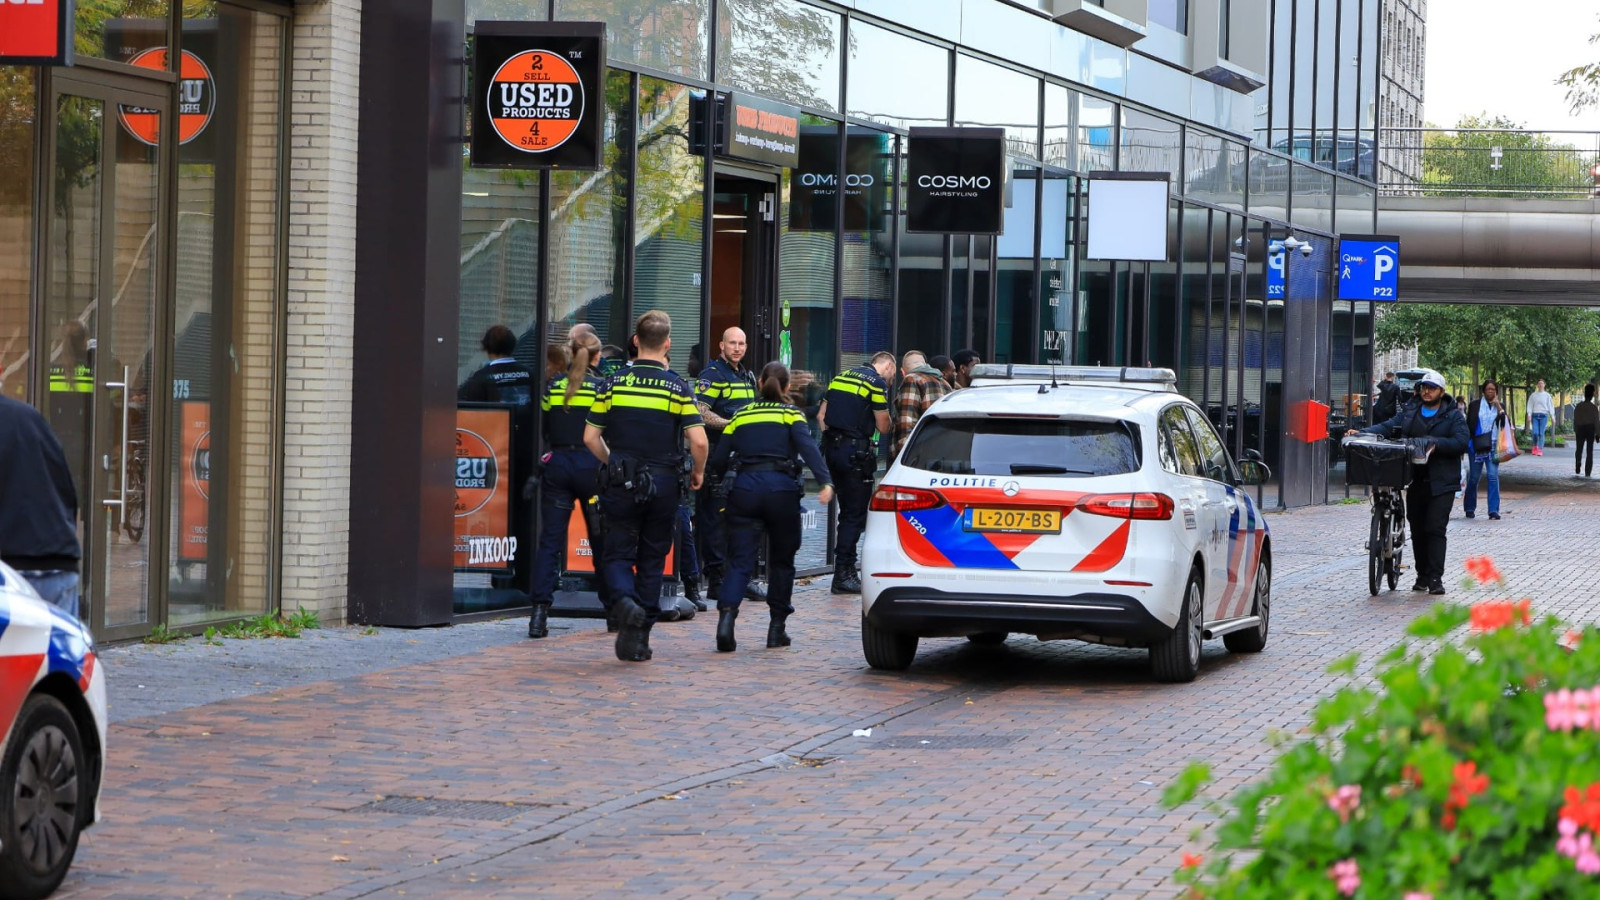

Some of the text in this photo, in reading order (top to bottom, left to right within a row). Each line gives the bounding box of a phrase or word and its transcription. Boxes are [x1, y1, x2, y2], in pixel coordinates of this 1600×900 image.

[531, 54, 543, 70] 2
[568, 51, 582, 59] TM
[523, 72, 551, 81] SELL
[500, 83, 573, 107] USED
[502, 107, 571, 118] PRODUCTS
[529, 121, 540, 136] 4
[520, 136, 548, 146] SALE
[917, 174, 991, 189] COSMO
[1374, 254, 1394, 281] P
[1373, 286, 1393, 297] P22
[929, 477, 998, 487] POLITIE
[908, 515, 927, 535] 1220
[978, 511, 1053, 528] L-207-BS
[469, 536, 518, 565] INKOOP
